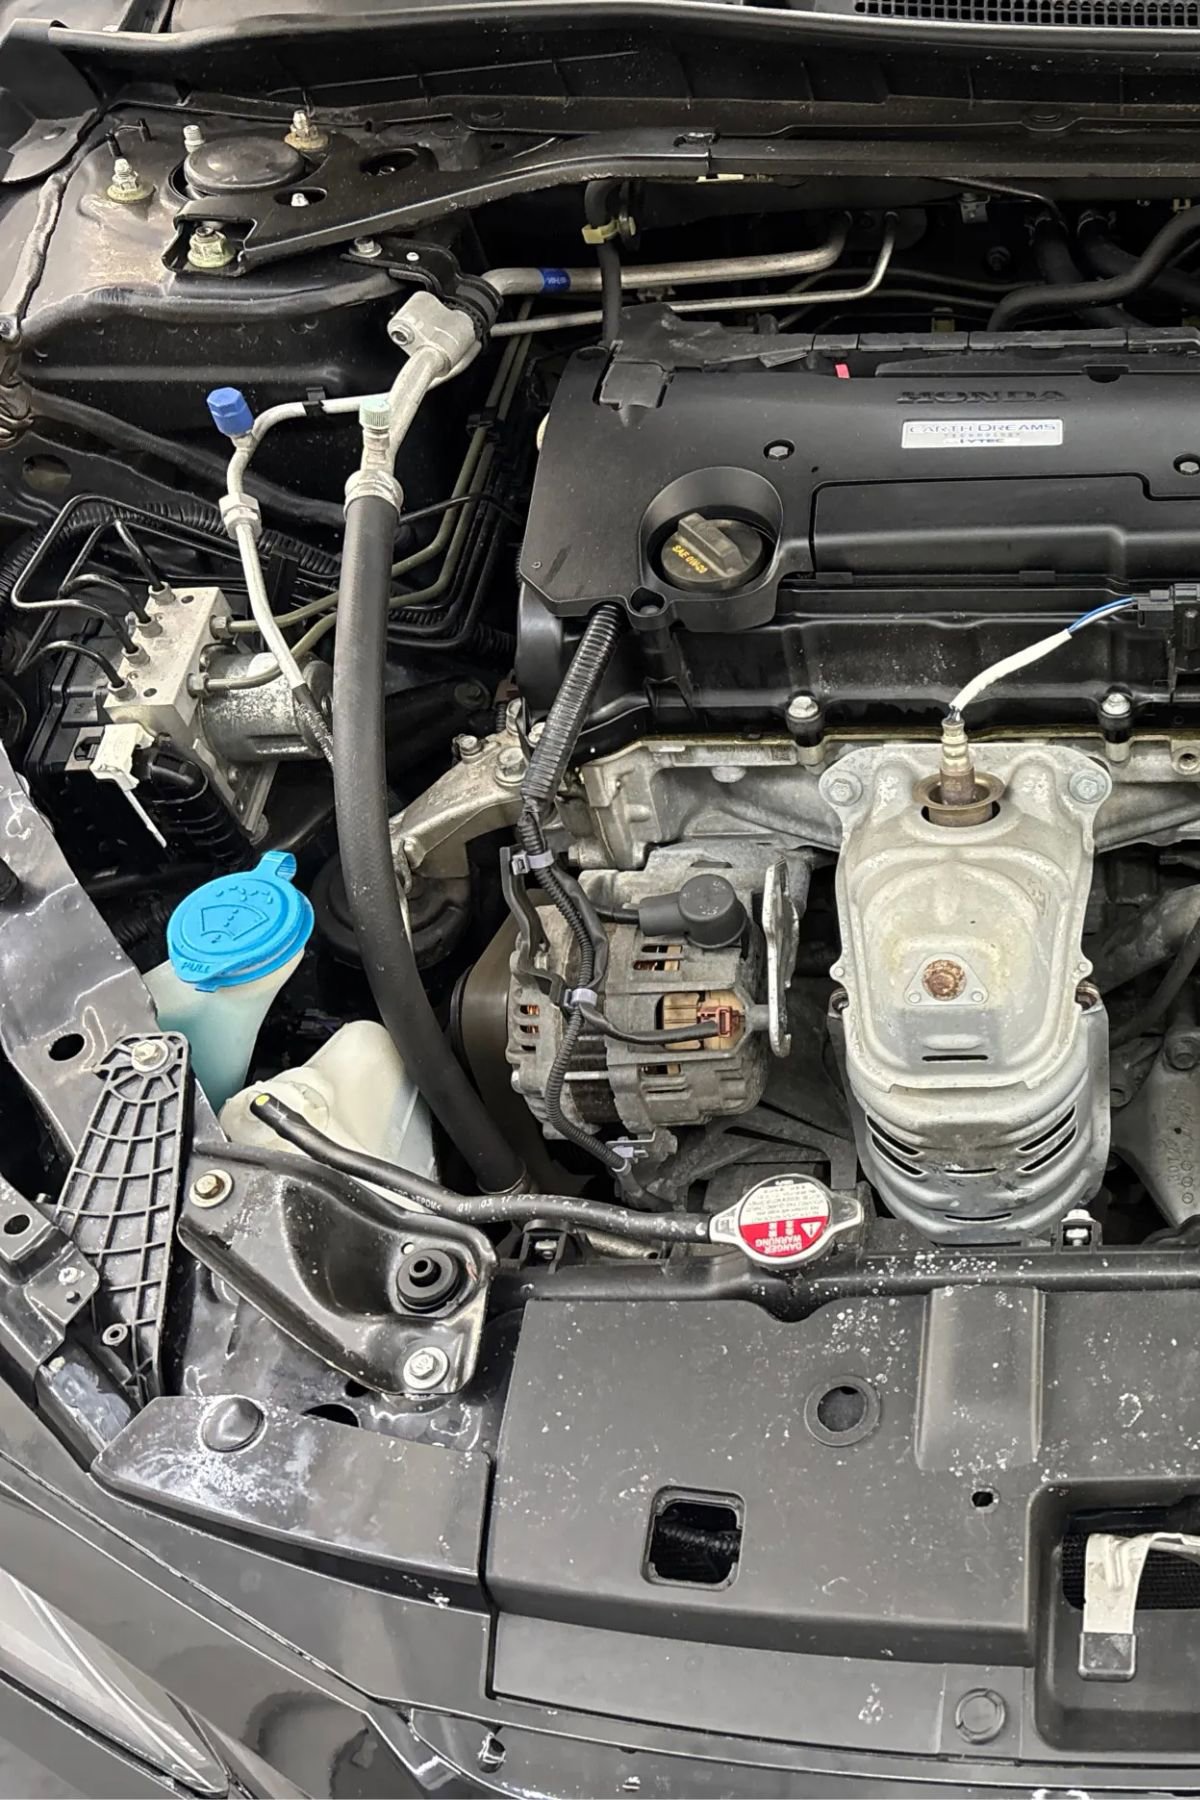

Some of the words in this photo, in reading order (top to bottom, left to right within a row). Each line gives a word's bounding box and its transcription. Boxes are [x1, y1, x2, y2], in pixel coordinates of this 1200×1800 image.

[897, 390, 1065, 404] HONDA
[910, 425, 972, 433] EARTH
[978, 423, 1056, 432] DREAMS
[755, 1234, 802, 1248] WARNUNG
[763, 1242, 803, 1254] DANGER
